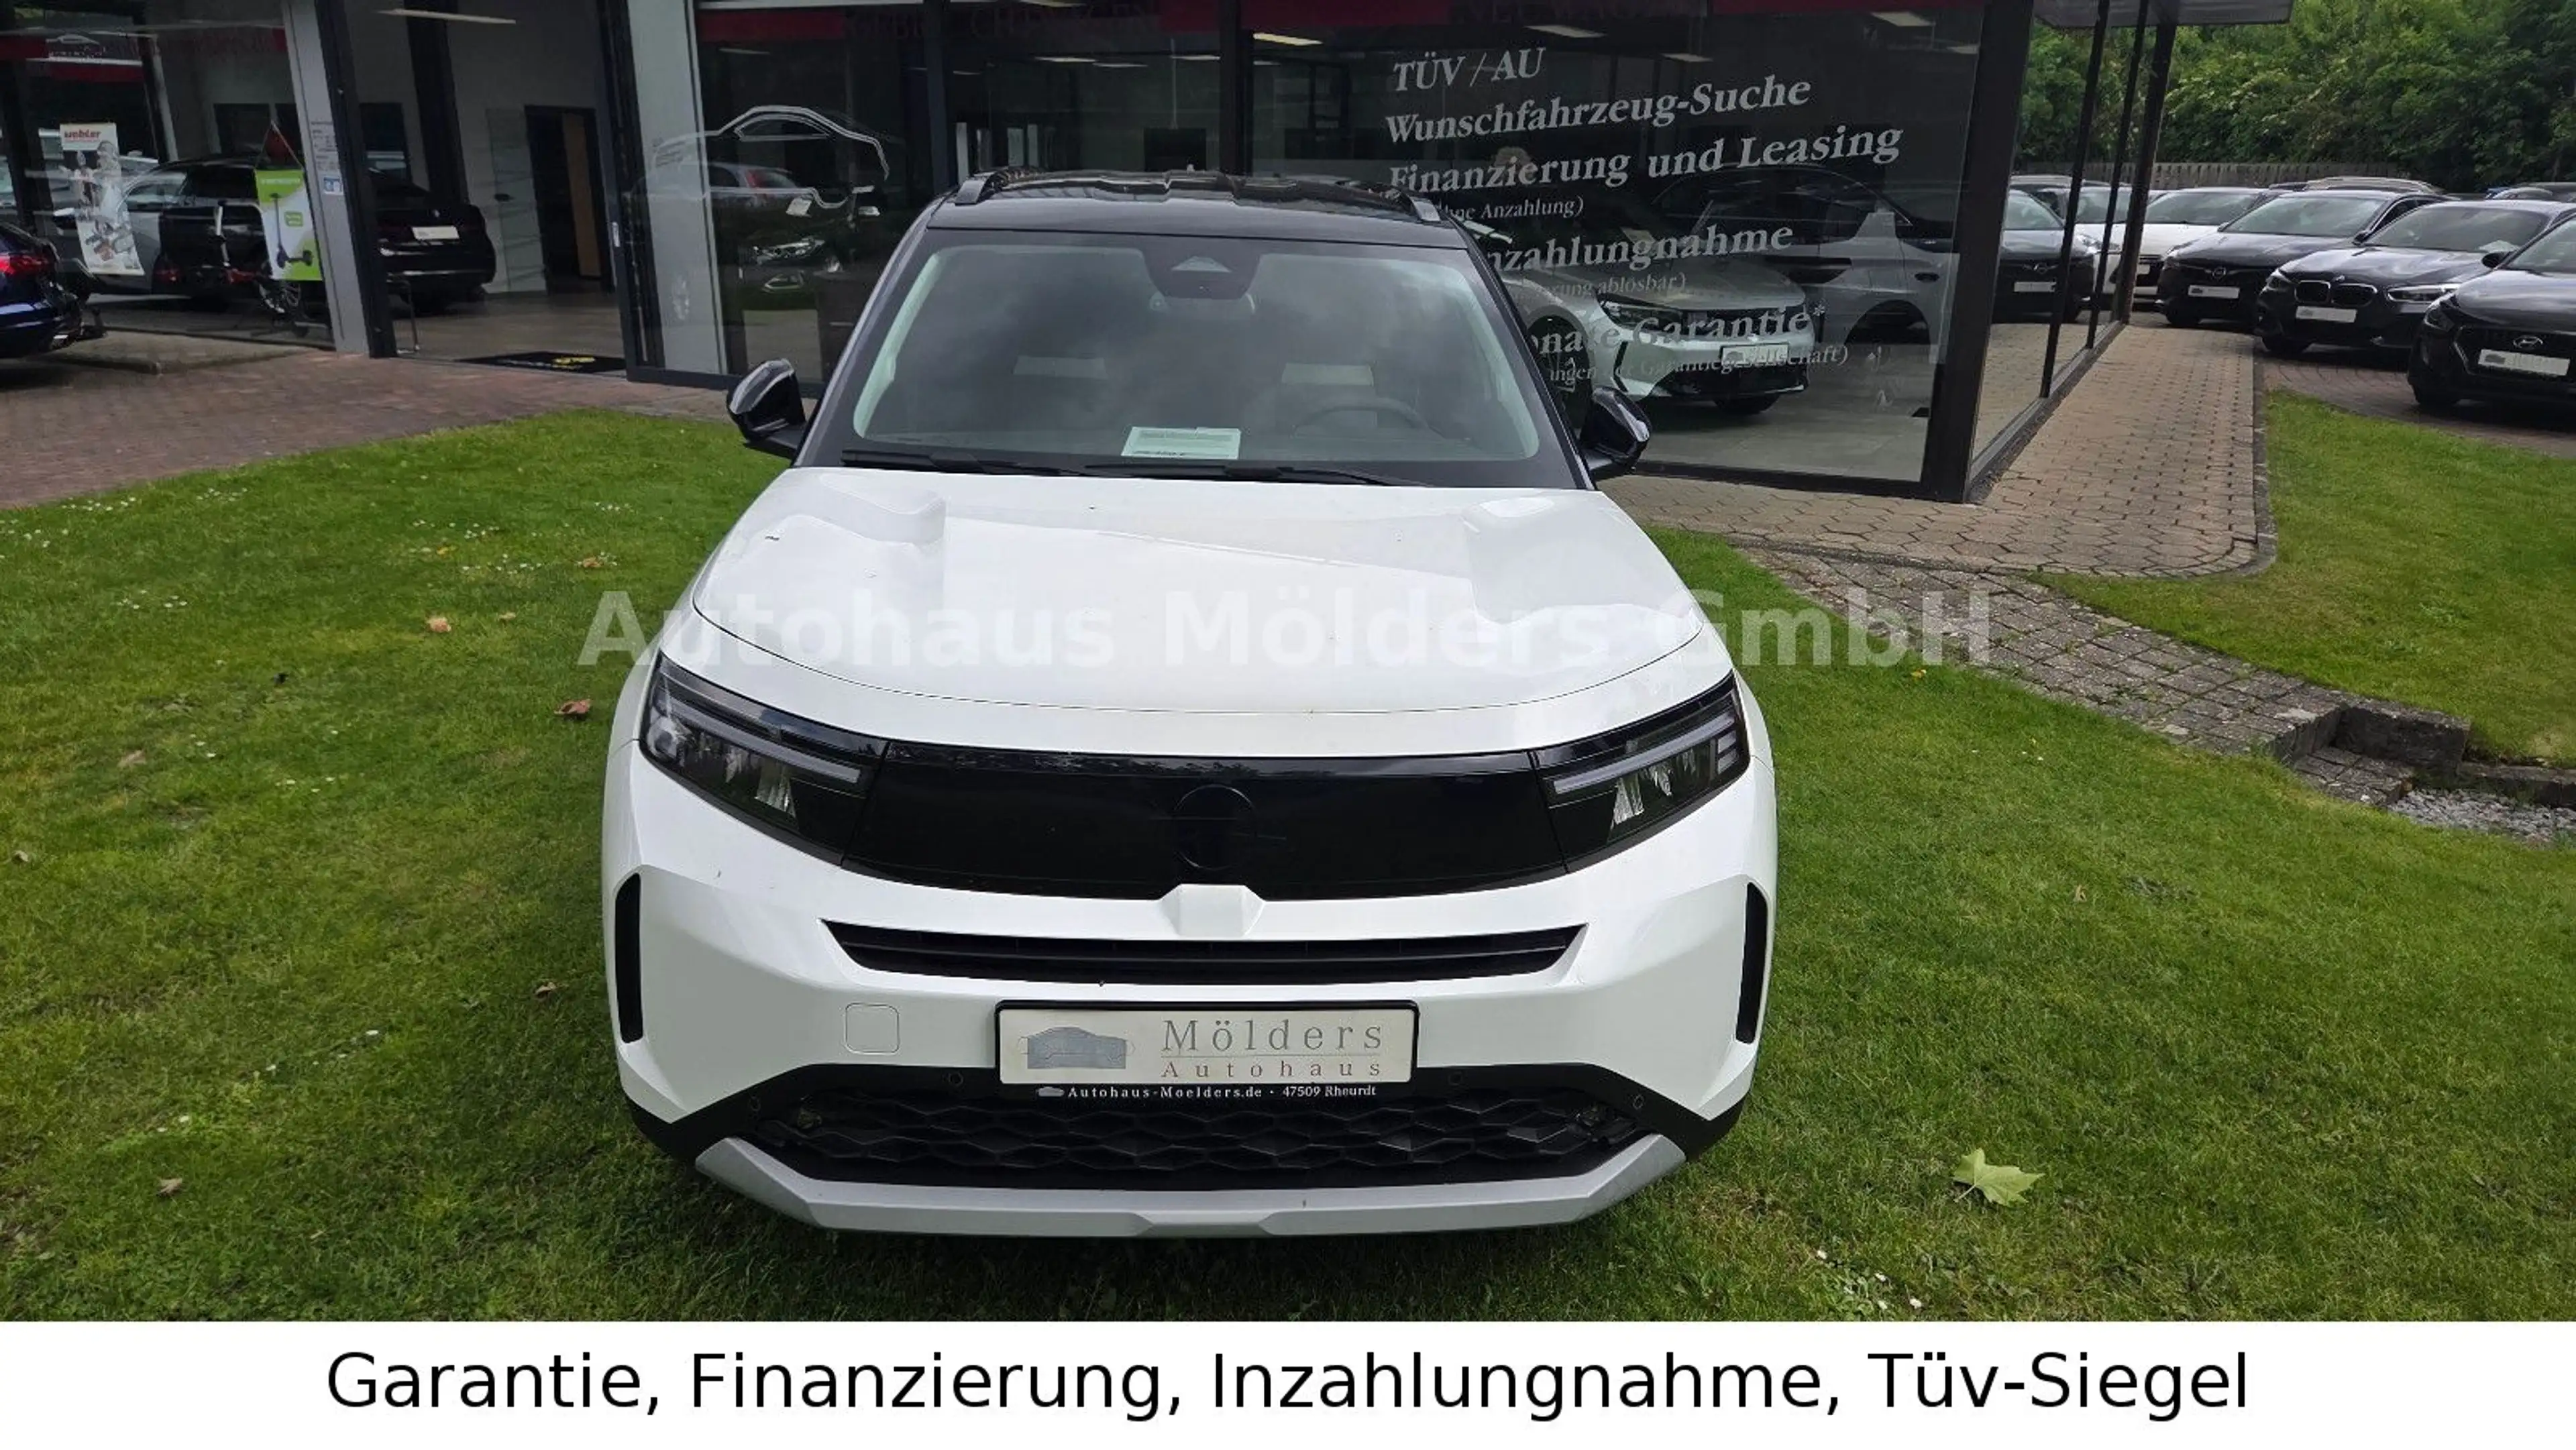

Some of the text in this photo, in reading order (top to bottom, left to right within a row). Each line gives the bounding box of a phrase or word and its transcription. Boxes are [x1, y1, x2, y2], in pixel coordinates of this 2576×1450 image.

[1393, 51, 1466, 91] TÜV
[1491, 47, 1546, 82] AU
[1385, 74, 1811, 143] Wunschfahrzeug-Suche
[1390, 125, 1904, 193] Finanzierung und Leasing
[1481, 196, 1585, 219] Anzahlung)
[1487, 225, 1794, 271] nzahlungnahme
[1161, 1019, 1382, 1052] Mölders
[1161, 1060, 1380, 1078] Autohaus
[1068, 1086, 1262, 1098] Autohaus-Moelders.de
[1282, 1085, 1320, 1097] 47509
[1325, 1084, 1377, 1096] Rheurdt
